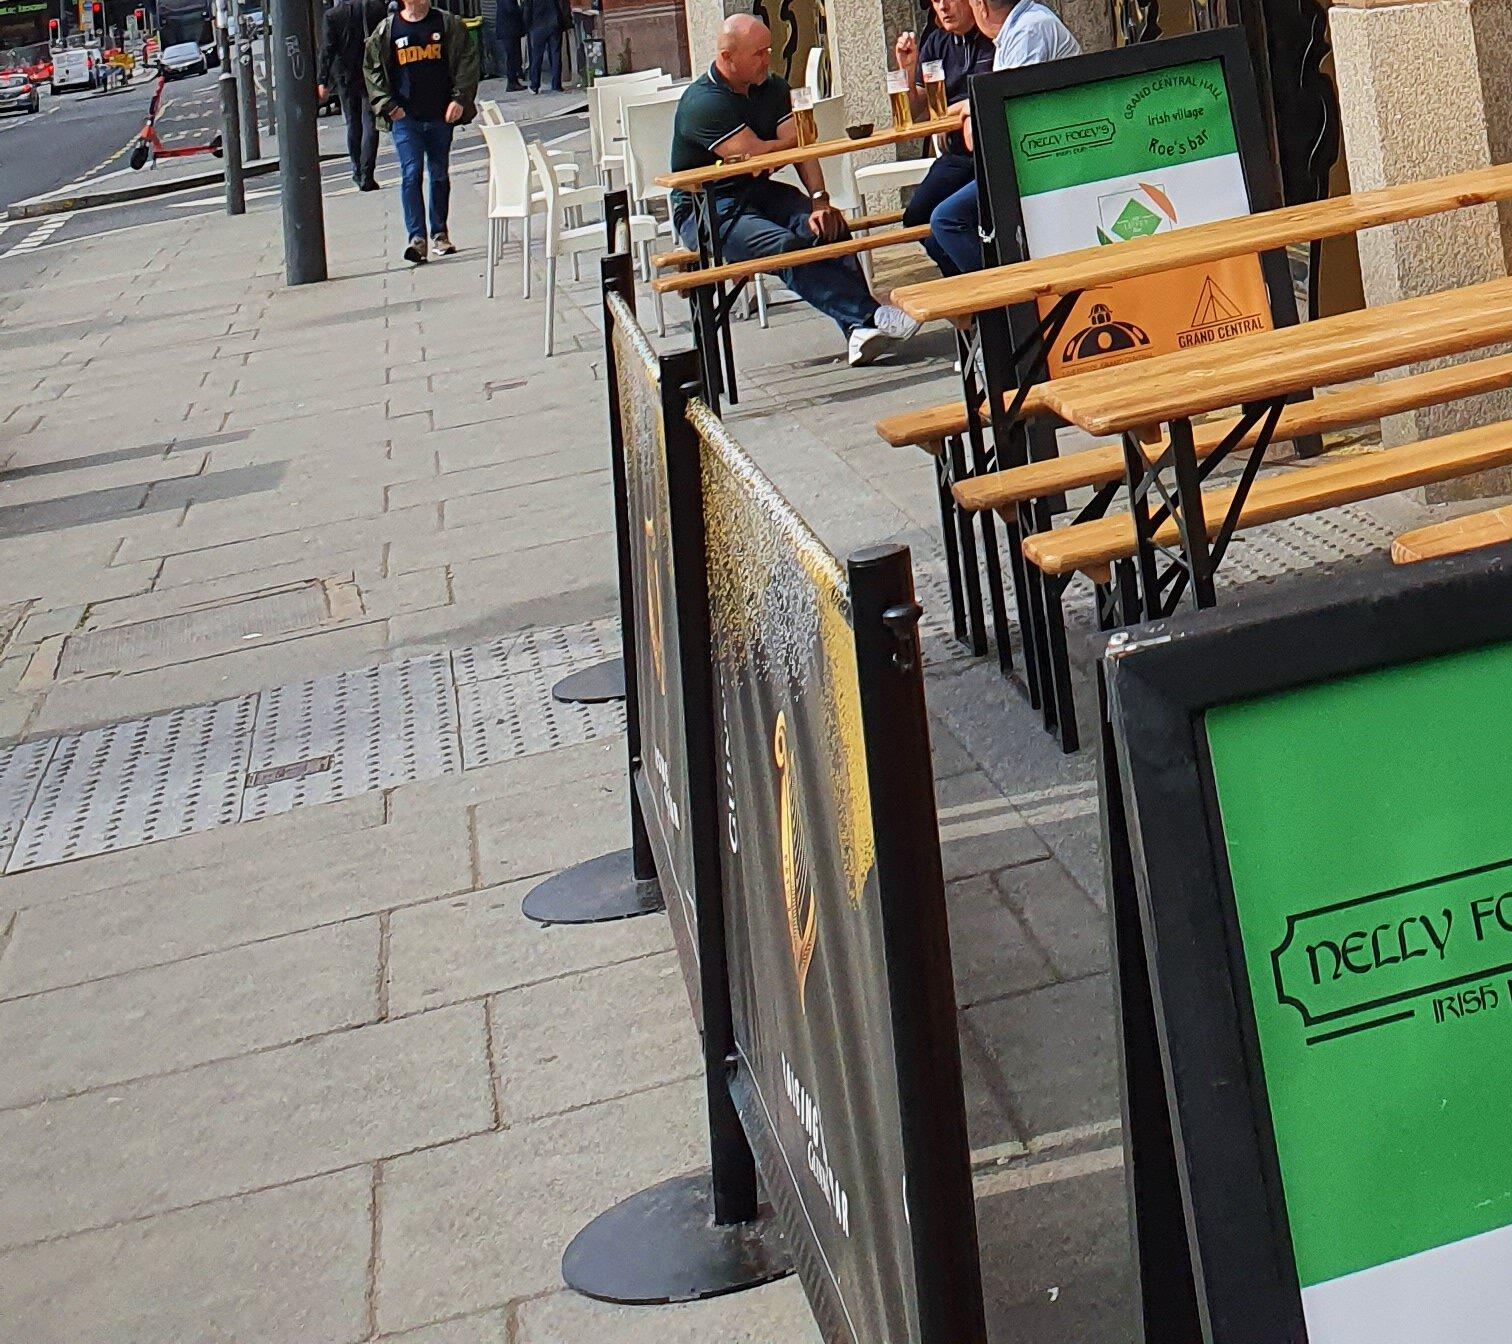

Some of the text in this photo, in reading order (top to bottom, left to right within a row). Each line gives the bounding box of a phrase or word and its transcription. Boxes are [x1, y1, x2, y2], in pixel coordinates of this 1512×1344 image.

[1124, 74, 1223, 120] GRAND CENTRAL HALL
[1172, 106, 1205, 123] village
[1149, 128, 1210, 157] Roe's bar
[1178, 316, 1264, 350] GRAND CENTRAL
[1305, 908, 1453, 985] NELLY
[1432, 983, 1500, 1023] IRISH
